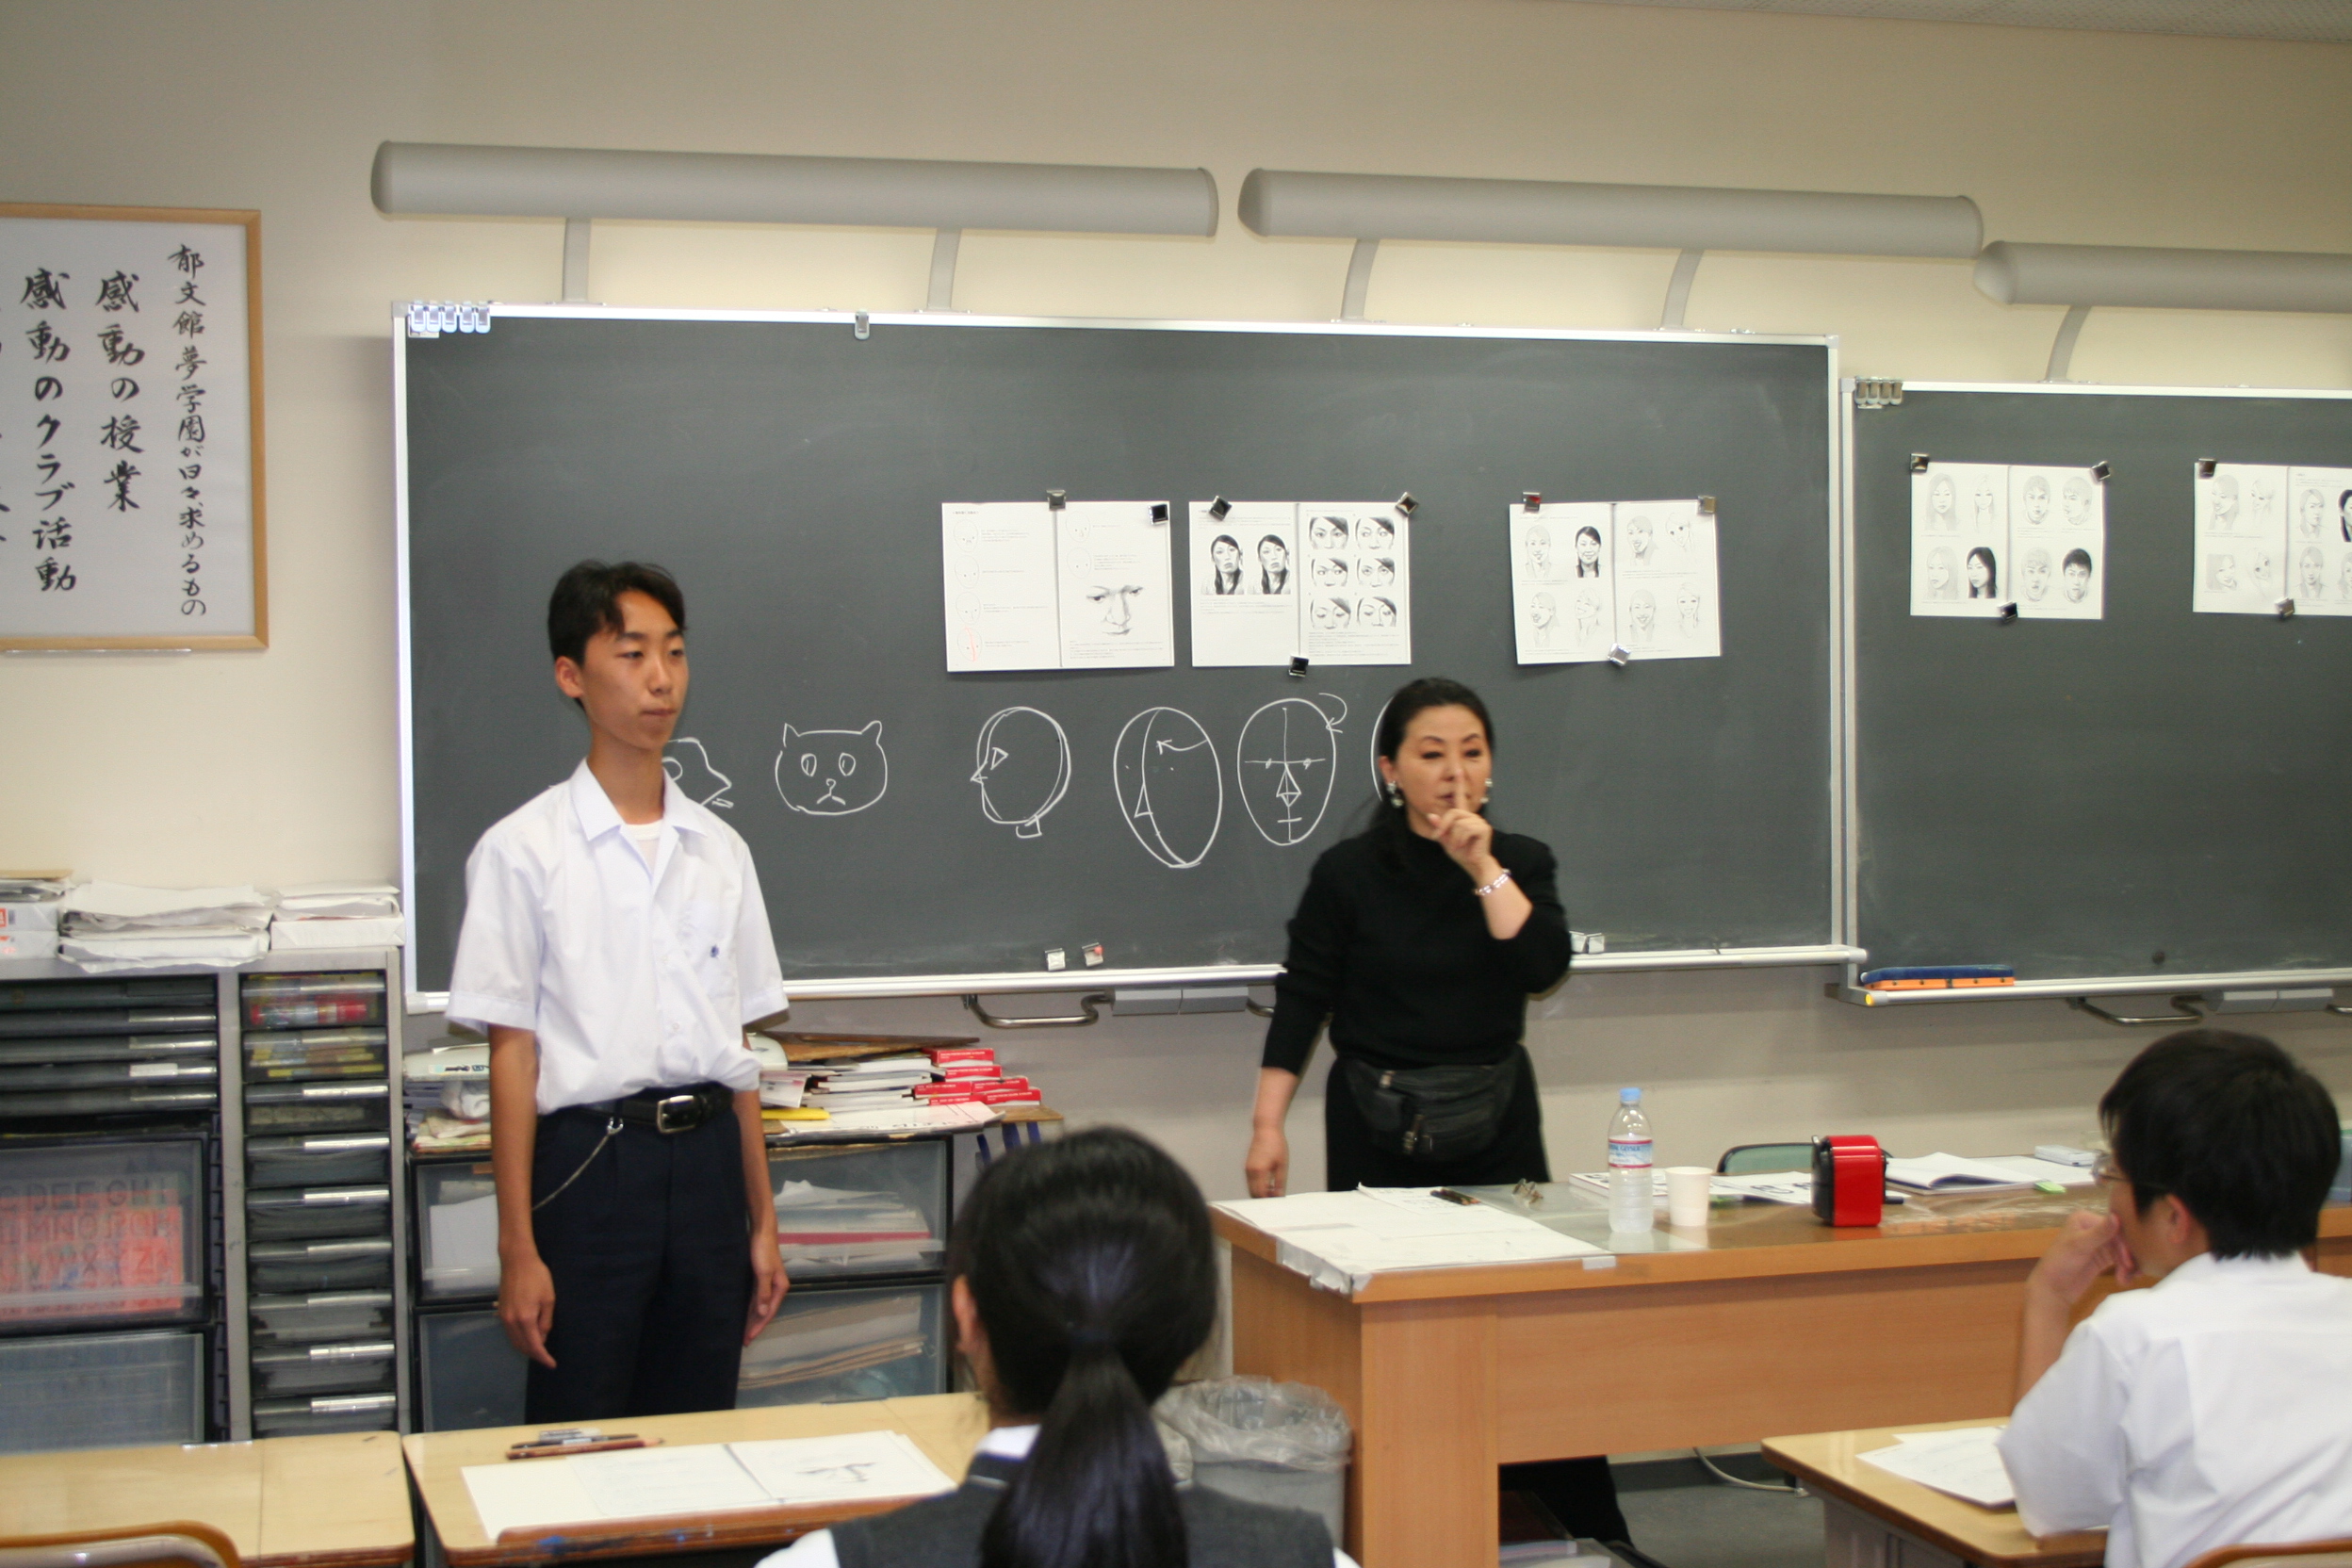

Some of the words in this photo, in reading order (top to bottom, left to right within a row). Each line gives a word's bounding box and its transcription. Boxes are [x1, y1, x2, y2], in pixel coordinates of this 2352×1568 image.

[21, 268, 76, 592] 感動のクラブ活動
[95, 270, 144, 512] 感動の授業
